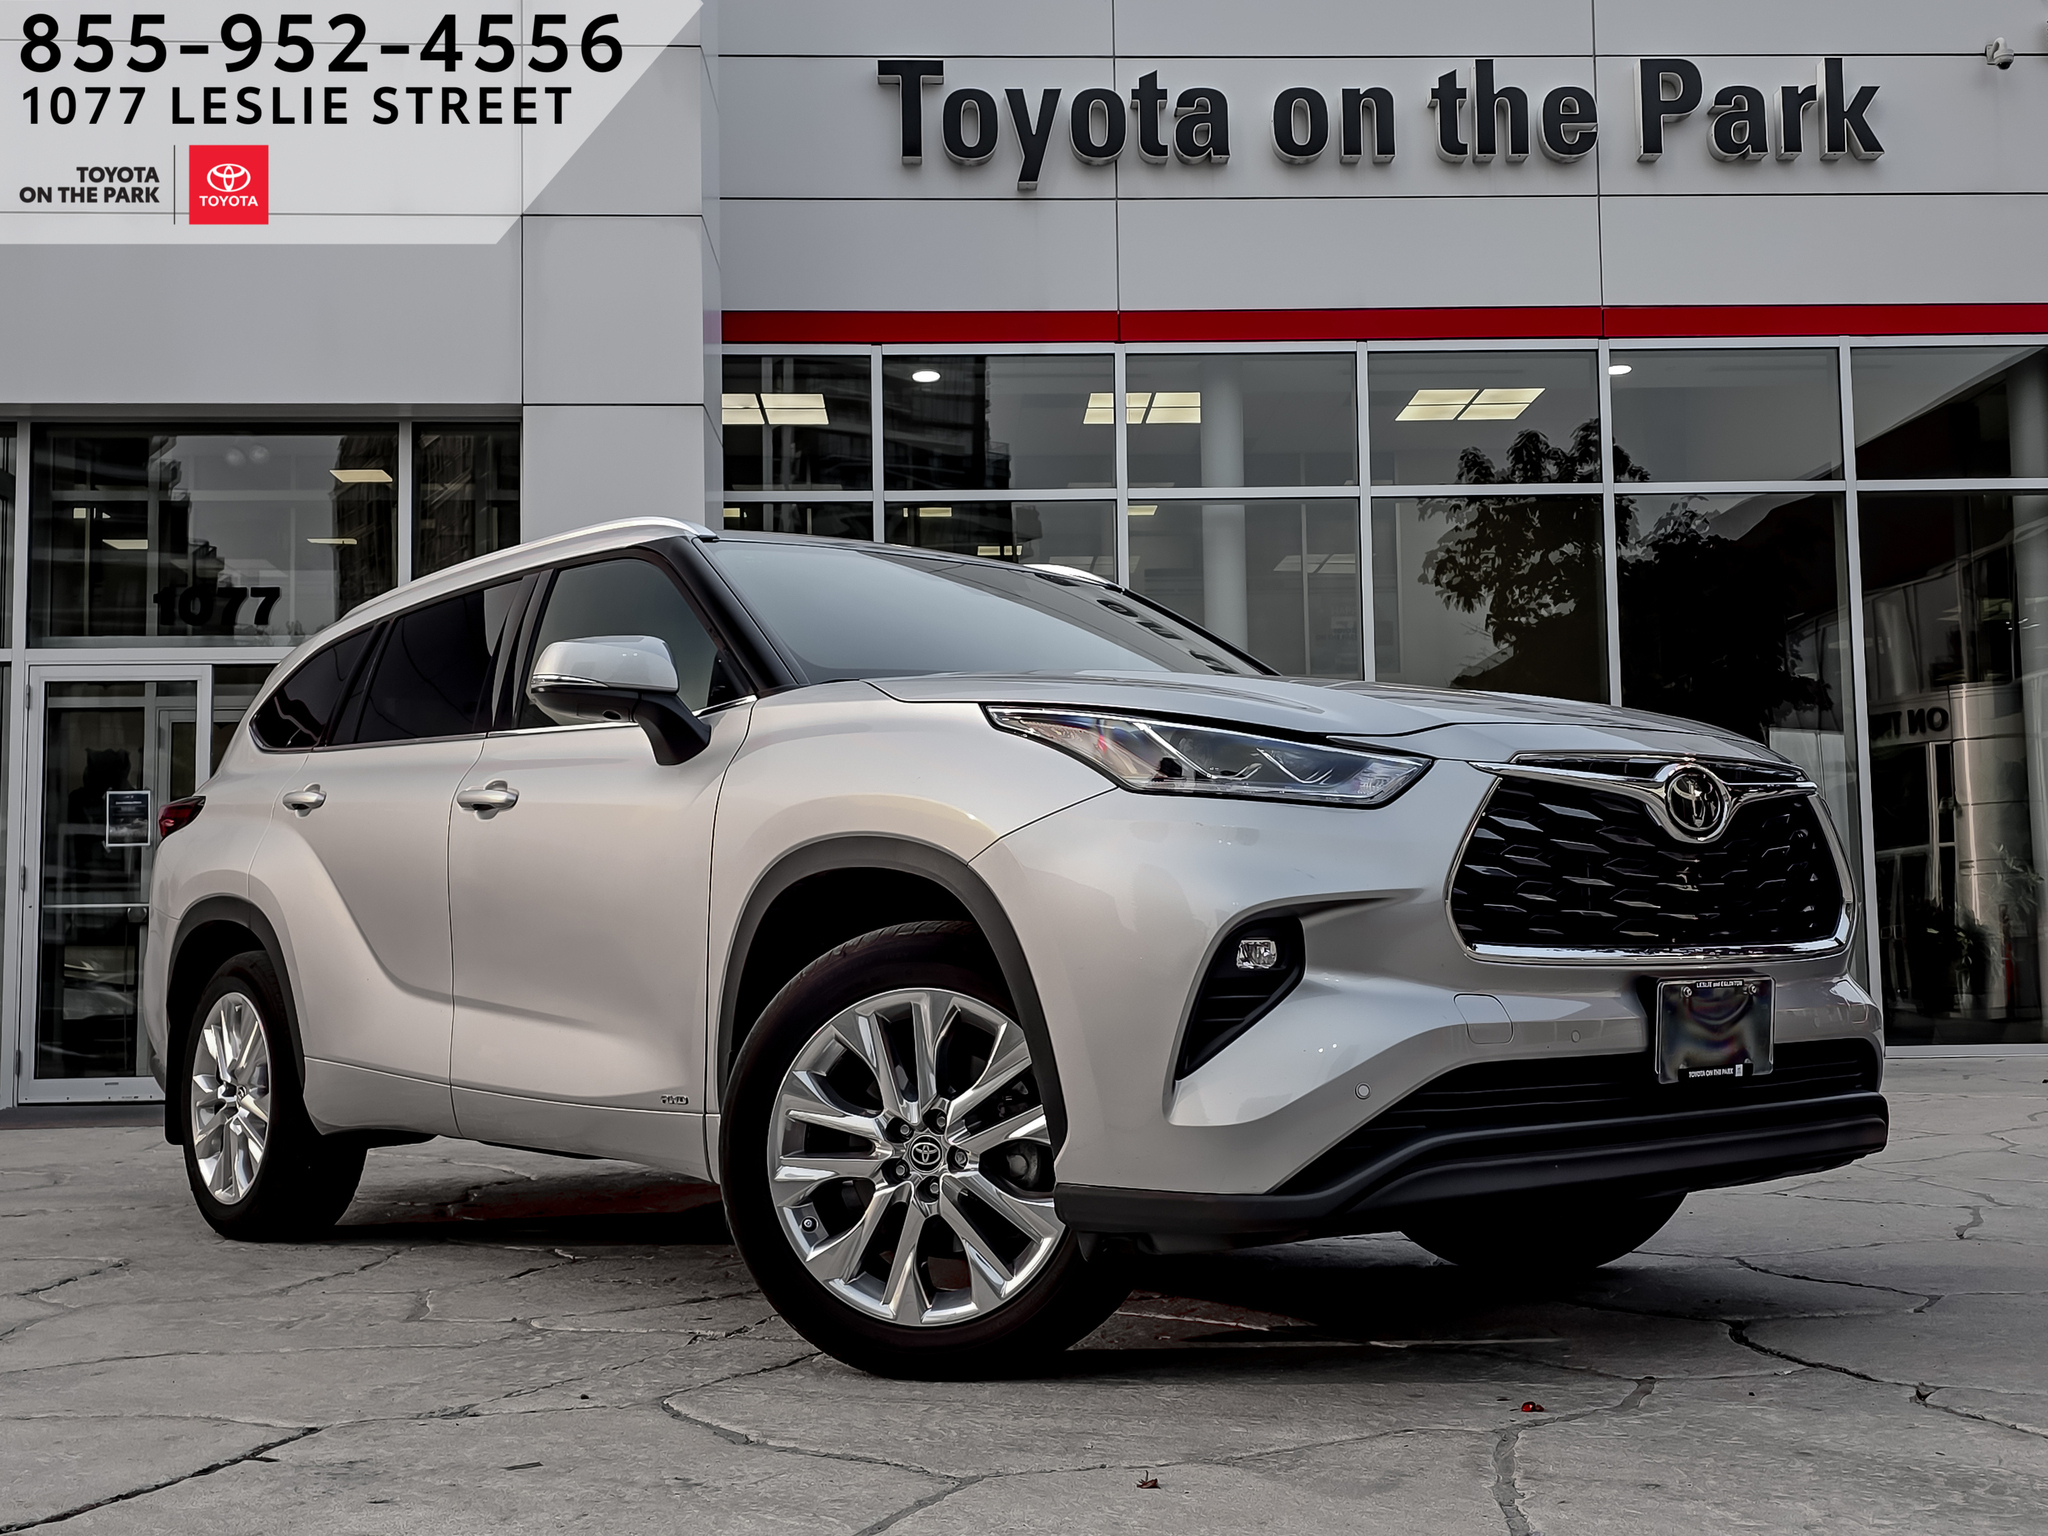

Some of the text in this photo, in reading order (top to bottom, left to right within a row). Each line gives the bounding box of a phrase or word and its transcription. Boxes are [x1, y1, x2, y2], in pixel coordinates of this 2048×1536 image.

[877, 57, 1886, 190] Toyota on the Park
[153, 586, 281, 626] 1077
